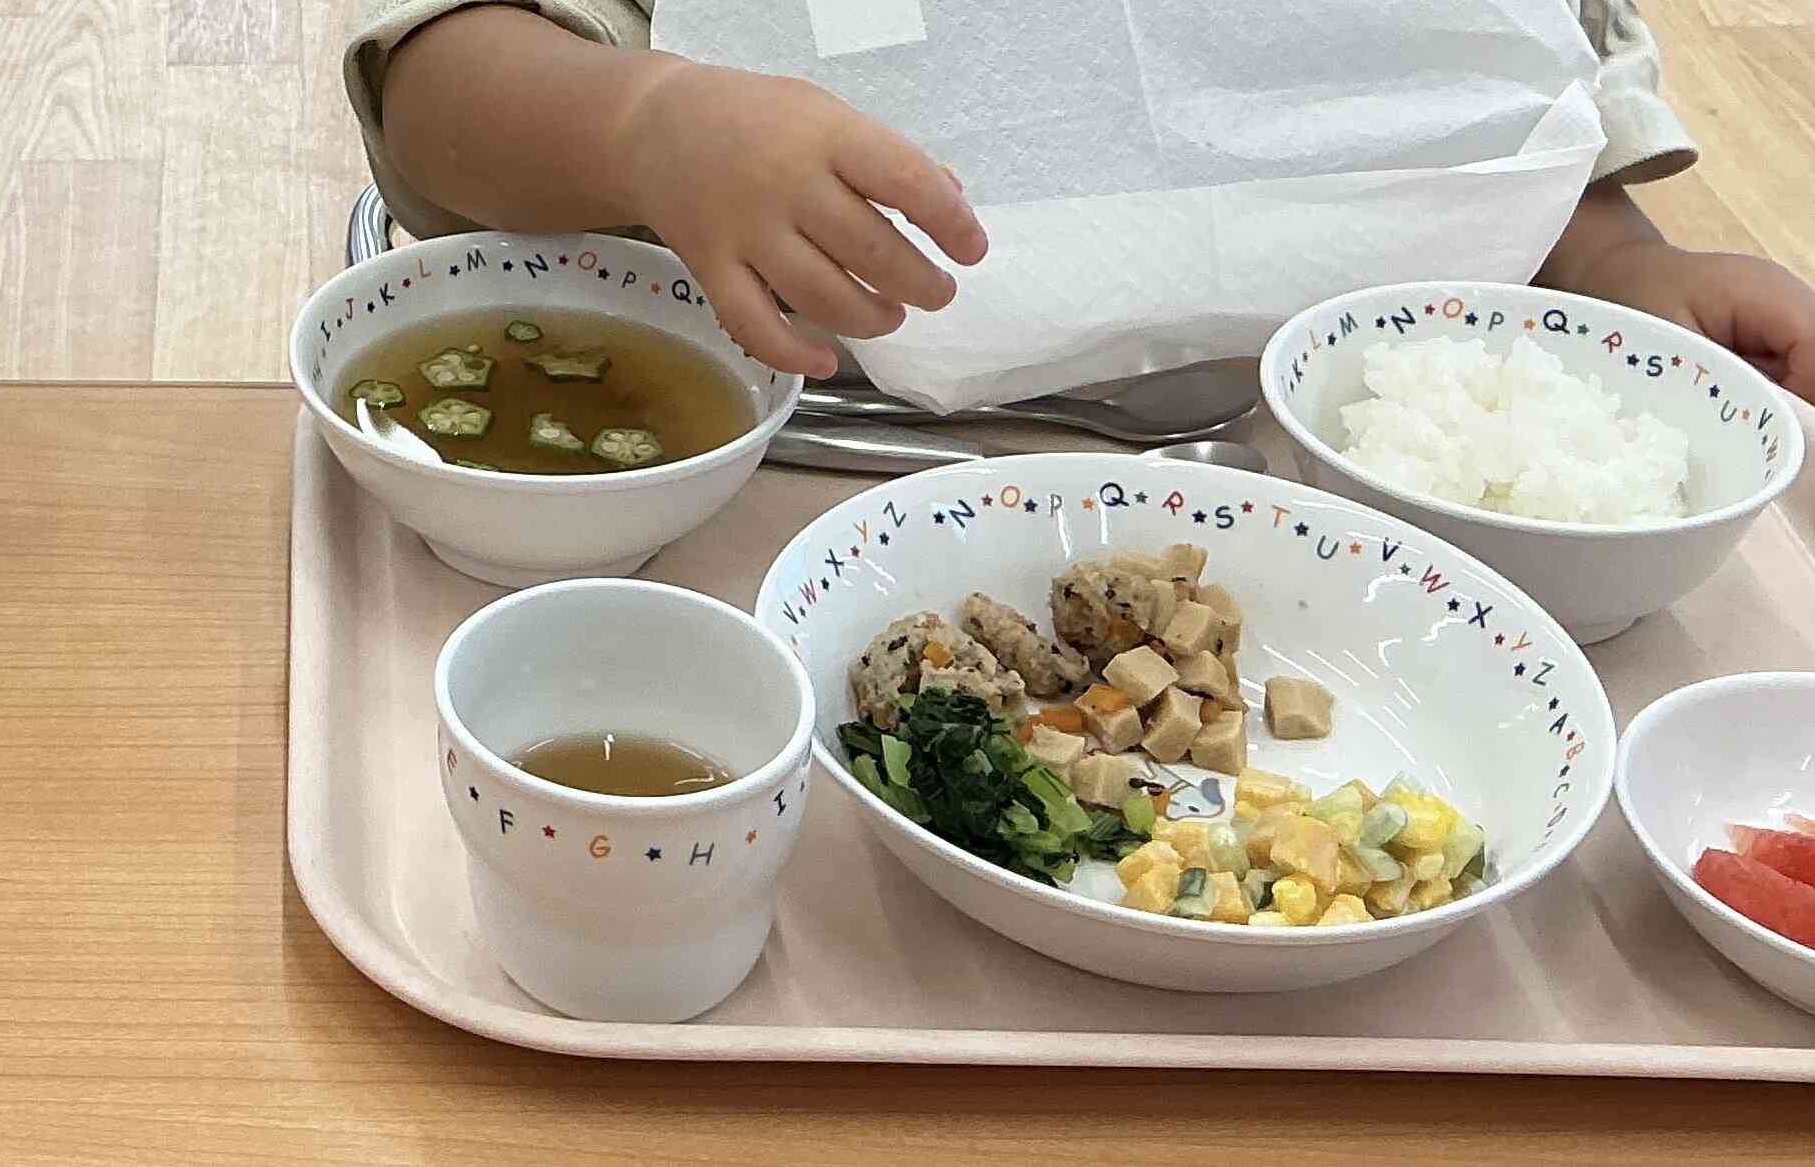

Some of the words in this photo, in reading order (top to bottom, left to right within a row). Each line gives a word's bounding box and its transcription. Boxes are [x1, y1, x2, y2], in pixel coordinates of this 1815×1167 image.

[321, 320, 331, 342] I
[344, 297, 354, 320] J
[380, 284, 395, 305] K
[417, 258, 433, 278] L
[467, 250, 487, 271] M
[524, 254, 549, 278] N
[578, 251, 597, 270] O
[622, 270, 637, 289] P
[671, 278, 692, 304] Q
[1338, 315, 1360, 337] M
[1391, 307, 1416, 333] N
[1443, 297, 1463, 318] O
[1488, 311, 1505, 332] P
[1543, 309, 1569, 333] Q
[1602, 331, 1622, 353] R
[1647, 355, 1663, 378] S
[1691, 364, 1709, 386] T
[1721, 400, 1738, 422] U
[1758, 407, 1773, 430] V
[825, 547, 844, 577] X
[853, 519, 869, 544] Y
[883, 500, 907, 527] Z
[949, 498, 975, 528] N
[1001, 484, 1020, 507] O
[1049, 492, 1063, 515] P
[1099, 481, 1129, 506] Q
[1162, 489, 1184, 515] R
[1215, 505, 1235, 529] S
[1272, 504, 1290, 527] T
[1317, 535, 1340, 560] U
[1382, 537, 1398, 561] V
[1420, 564, 1449, 593] W
[1468, 601, 1492, 628] X
[1510, 630, 1532, 651] Y
[1532, 661, 1555, 685] Z
[1549, 712, 1568, 734] A
[499, 808, 513, 834] F
[589, 834, 611, 859] G
[690, 842, 715, 866] H
[773, 789, 786, 816] I
